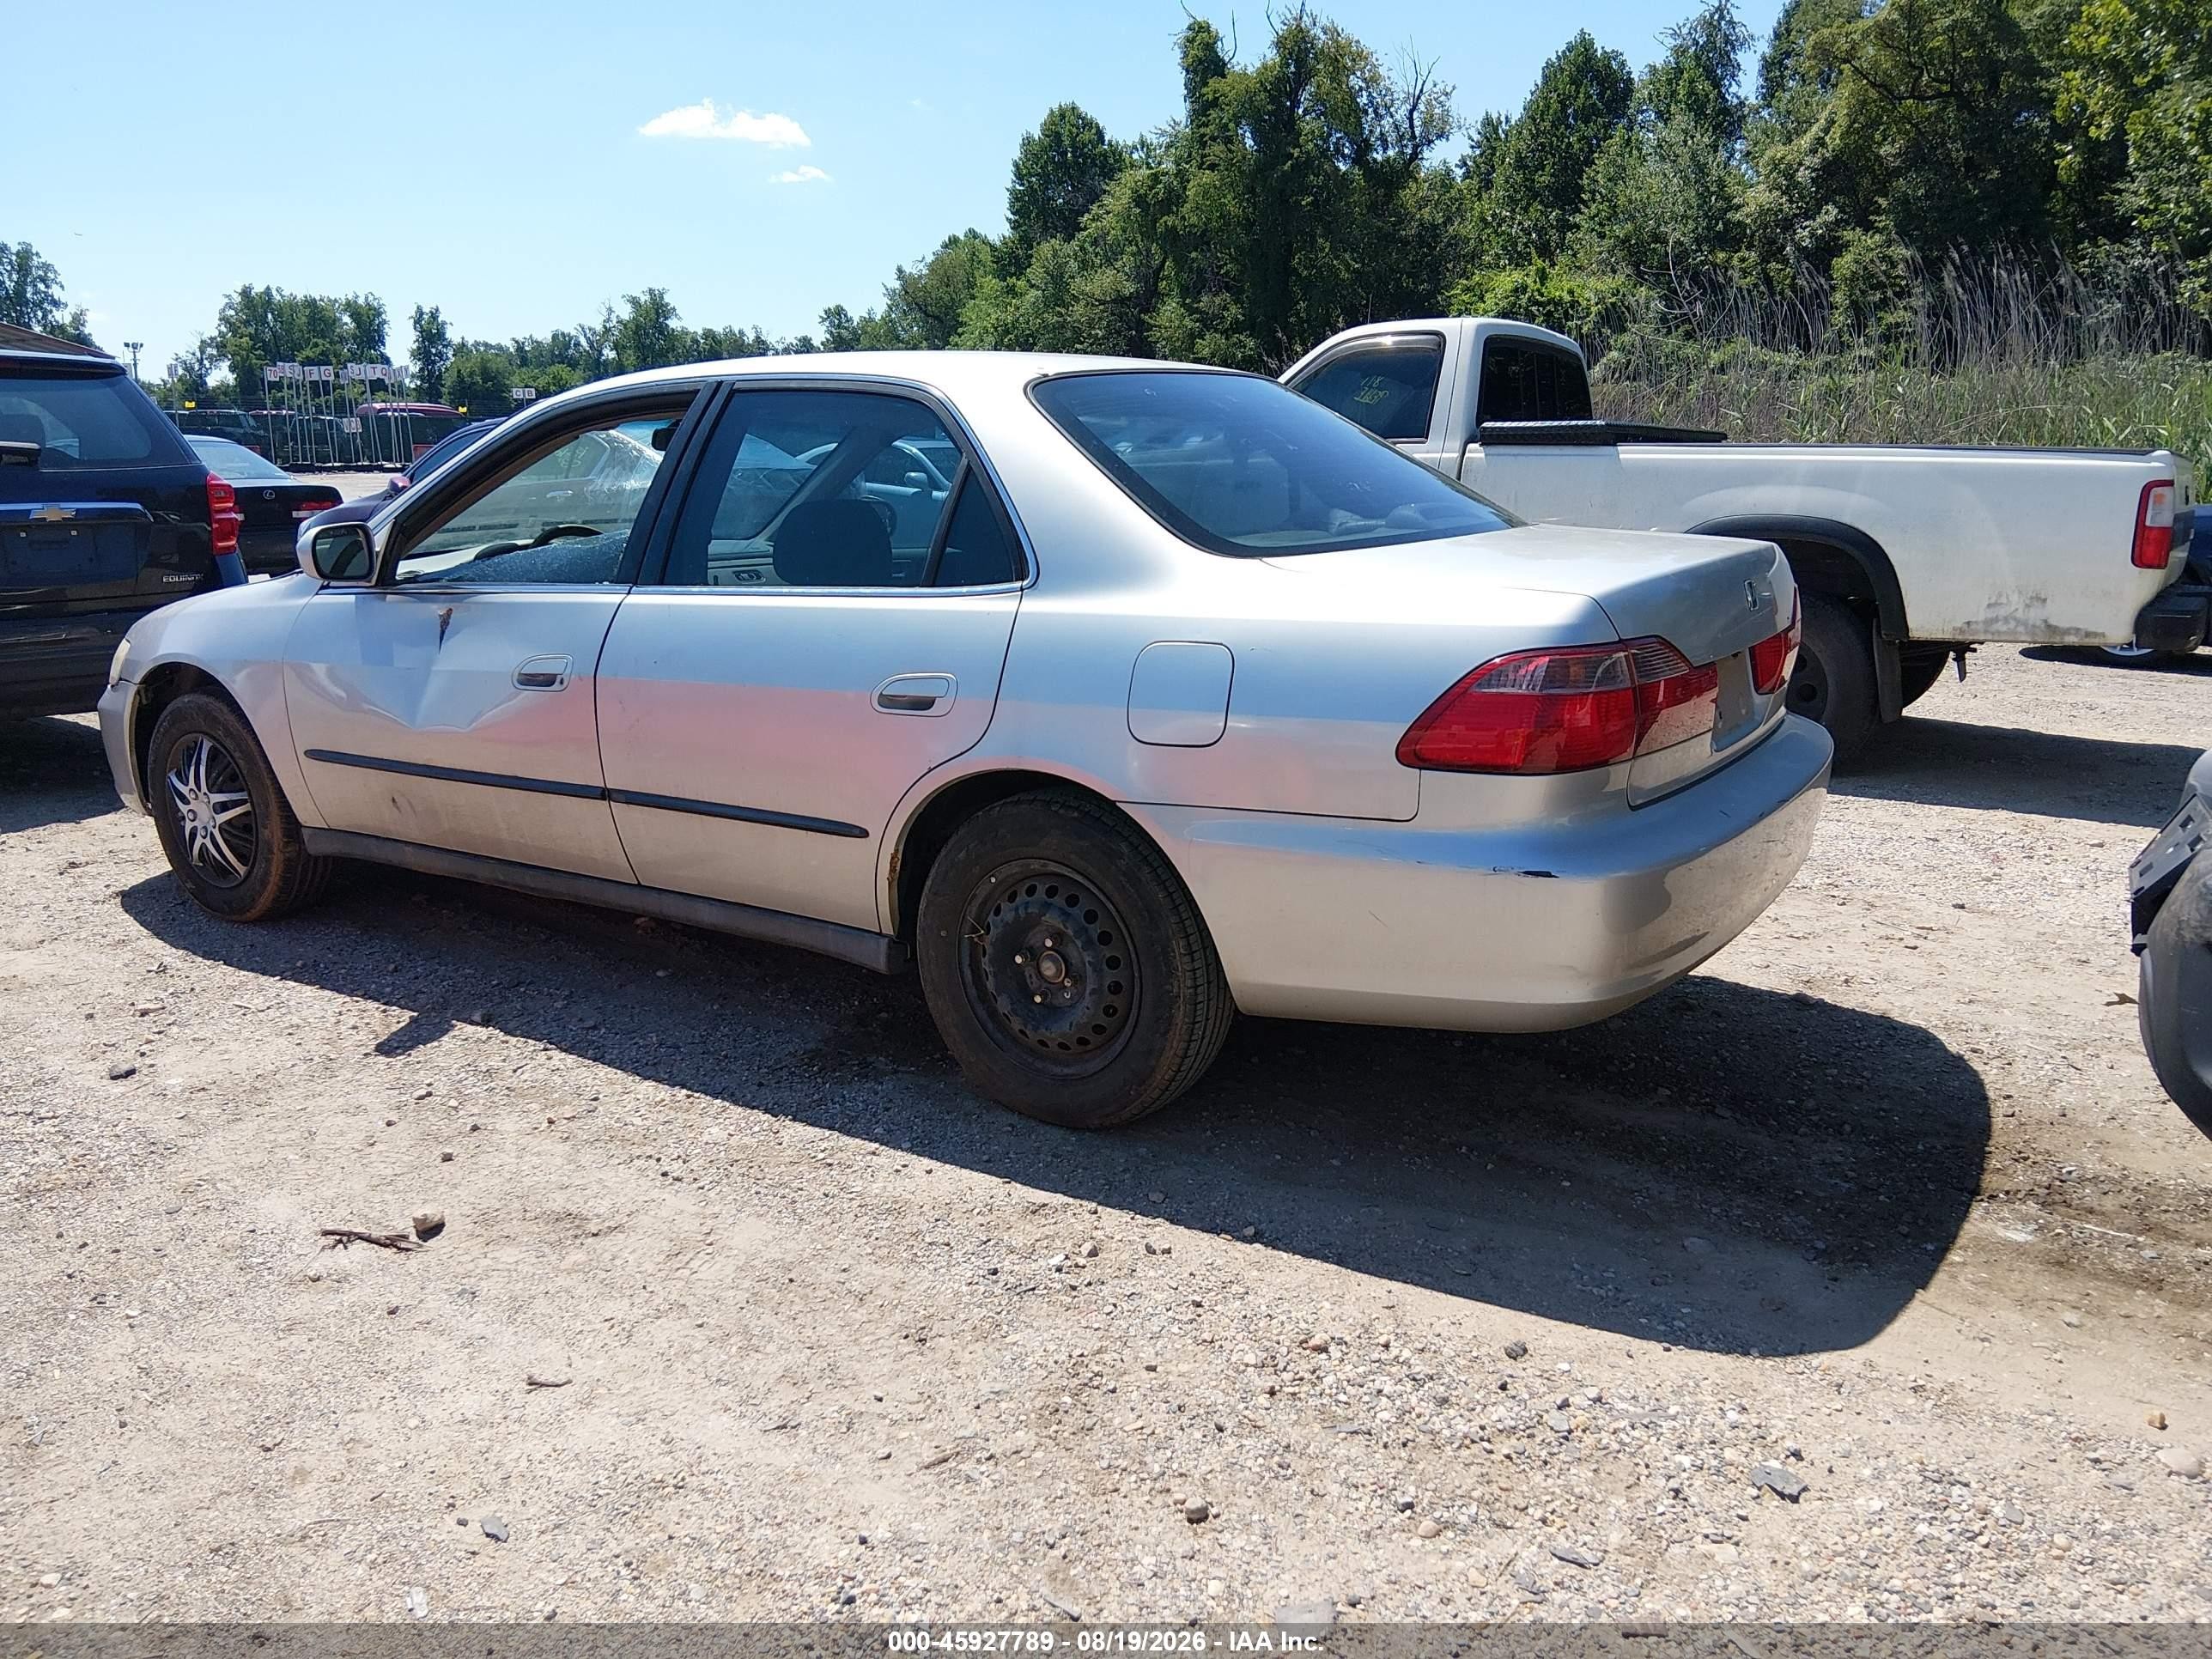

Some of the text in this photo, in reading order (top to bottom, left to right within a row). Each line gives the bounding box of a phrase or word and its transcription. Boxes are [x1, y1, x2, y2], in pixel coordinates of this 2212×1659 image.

[267, 368, 278, 379] 70
[308, 368, 314, 378] F
[323, 368, 331, 378] G
[356, 367, 362, 376] J
[370, 367, 378, 376] T
[380, 368, 387, 377] Q
